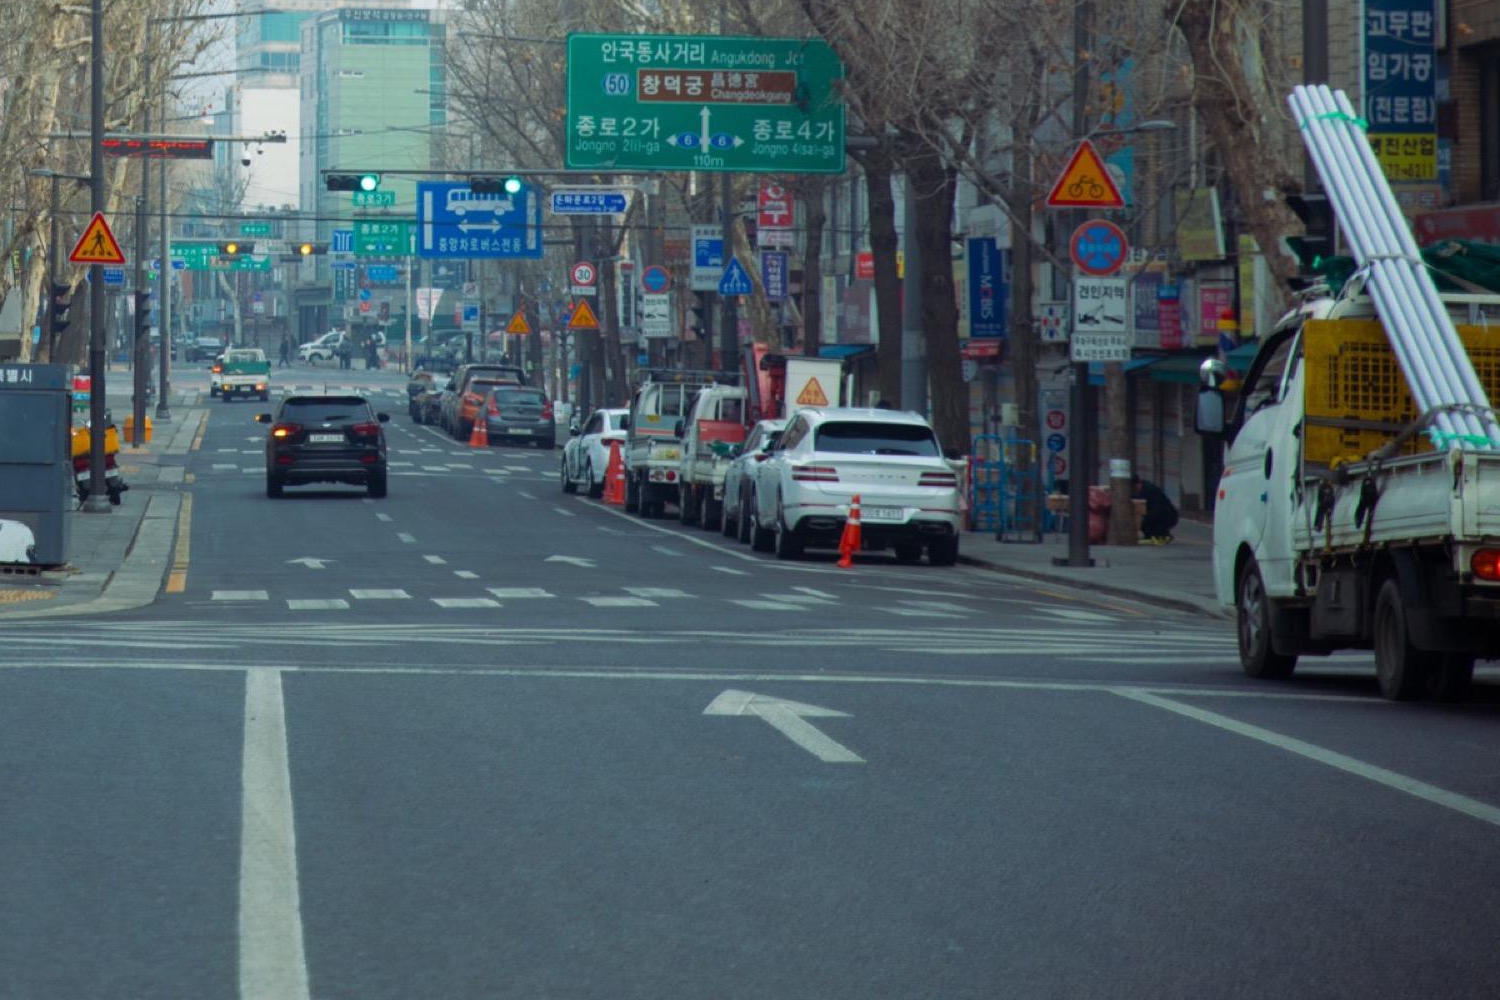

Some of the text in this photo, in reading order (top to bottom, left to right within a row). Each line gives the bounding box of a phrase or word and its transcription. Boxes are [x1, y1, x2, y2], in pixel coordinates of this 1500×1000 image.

[1367, 9, 1432, 38] 고무판
[601, 40, 705, 64] 안국동사거리
[710, 49, 776, 68] Angukdong
[1367, 52, 1432, 83] 임가공
[607, 74, 627, 94] 50
[643, 74, 704, 96] 창덕궁
[1367, 94, 1436, 125] (전문점)
[575, 115, 661, 139] 종로2가
[752, 119, 835, 142] 종로4가
[575, 139, 616, 154] Jongno
[751, 141, 789, 158] Jongno
[693, 154, 725, 167] 110m
[438, 237, 522, 253] 중앙차로버스전용
[576, 268, 592, 281] 30
[979, 274, 995, 320] MOBIS
[1078, 284, 1125, 300] 견인지역
